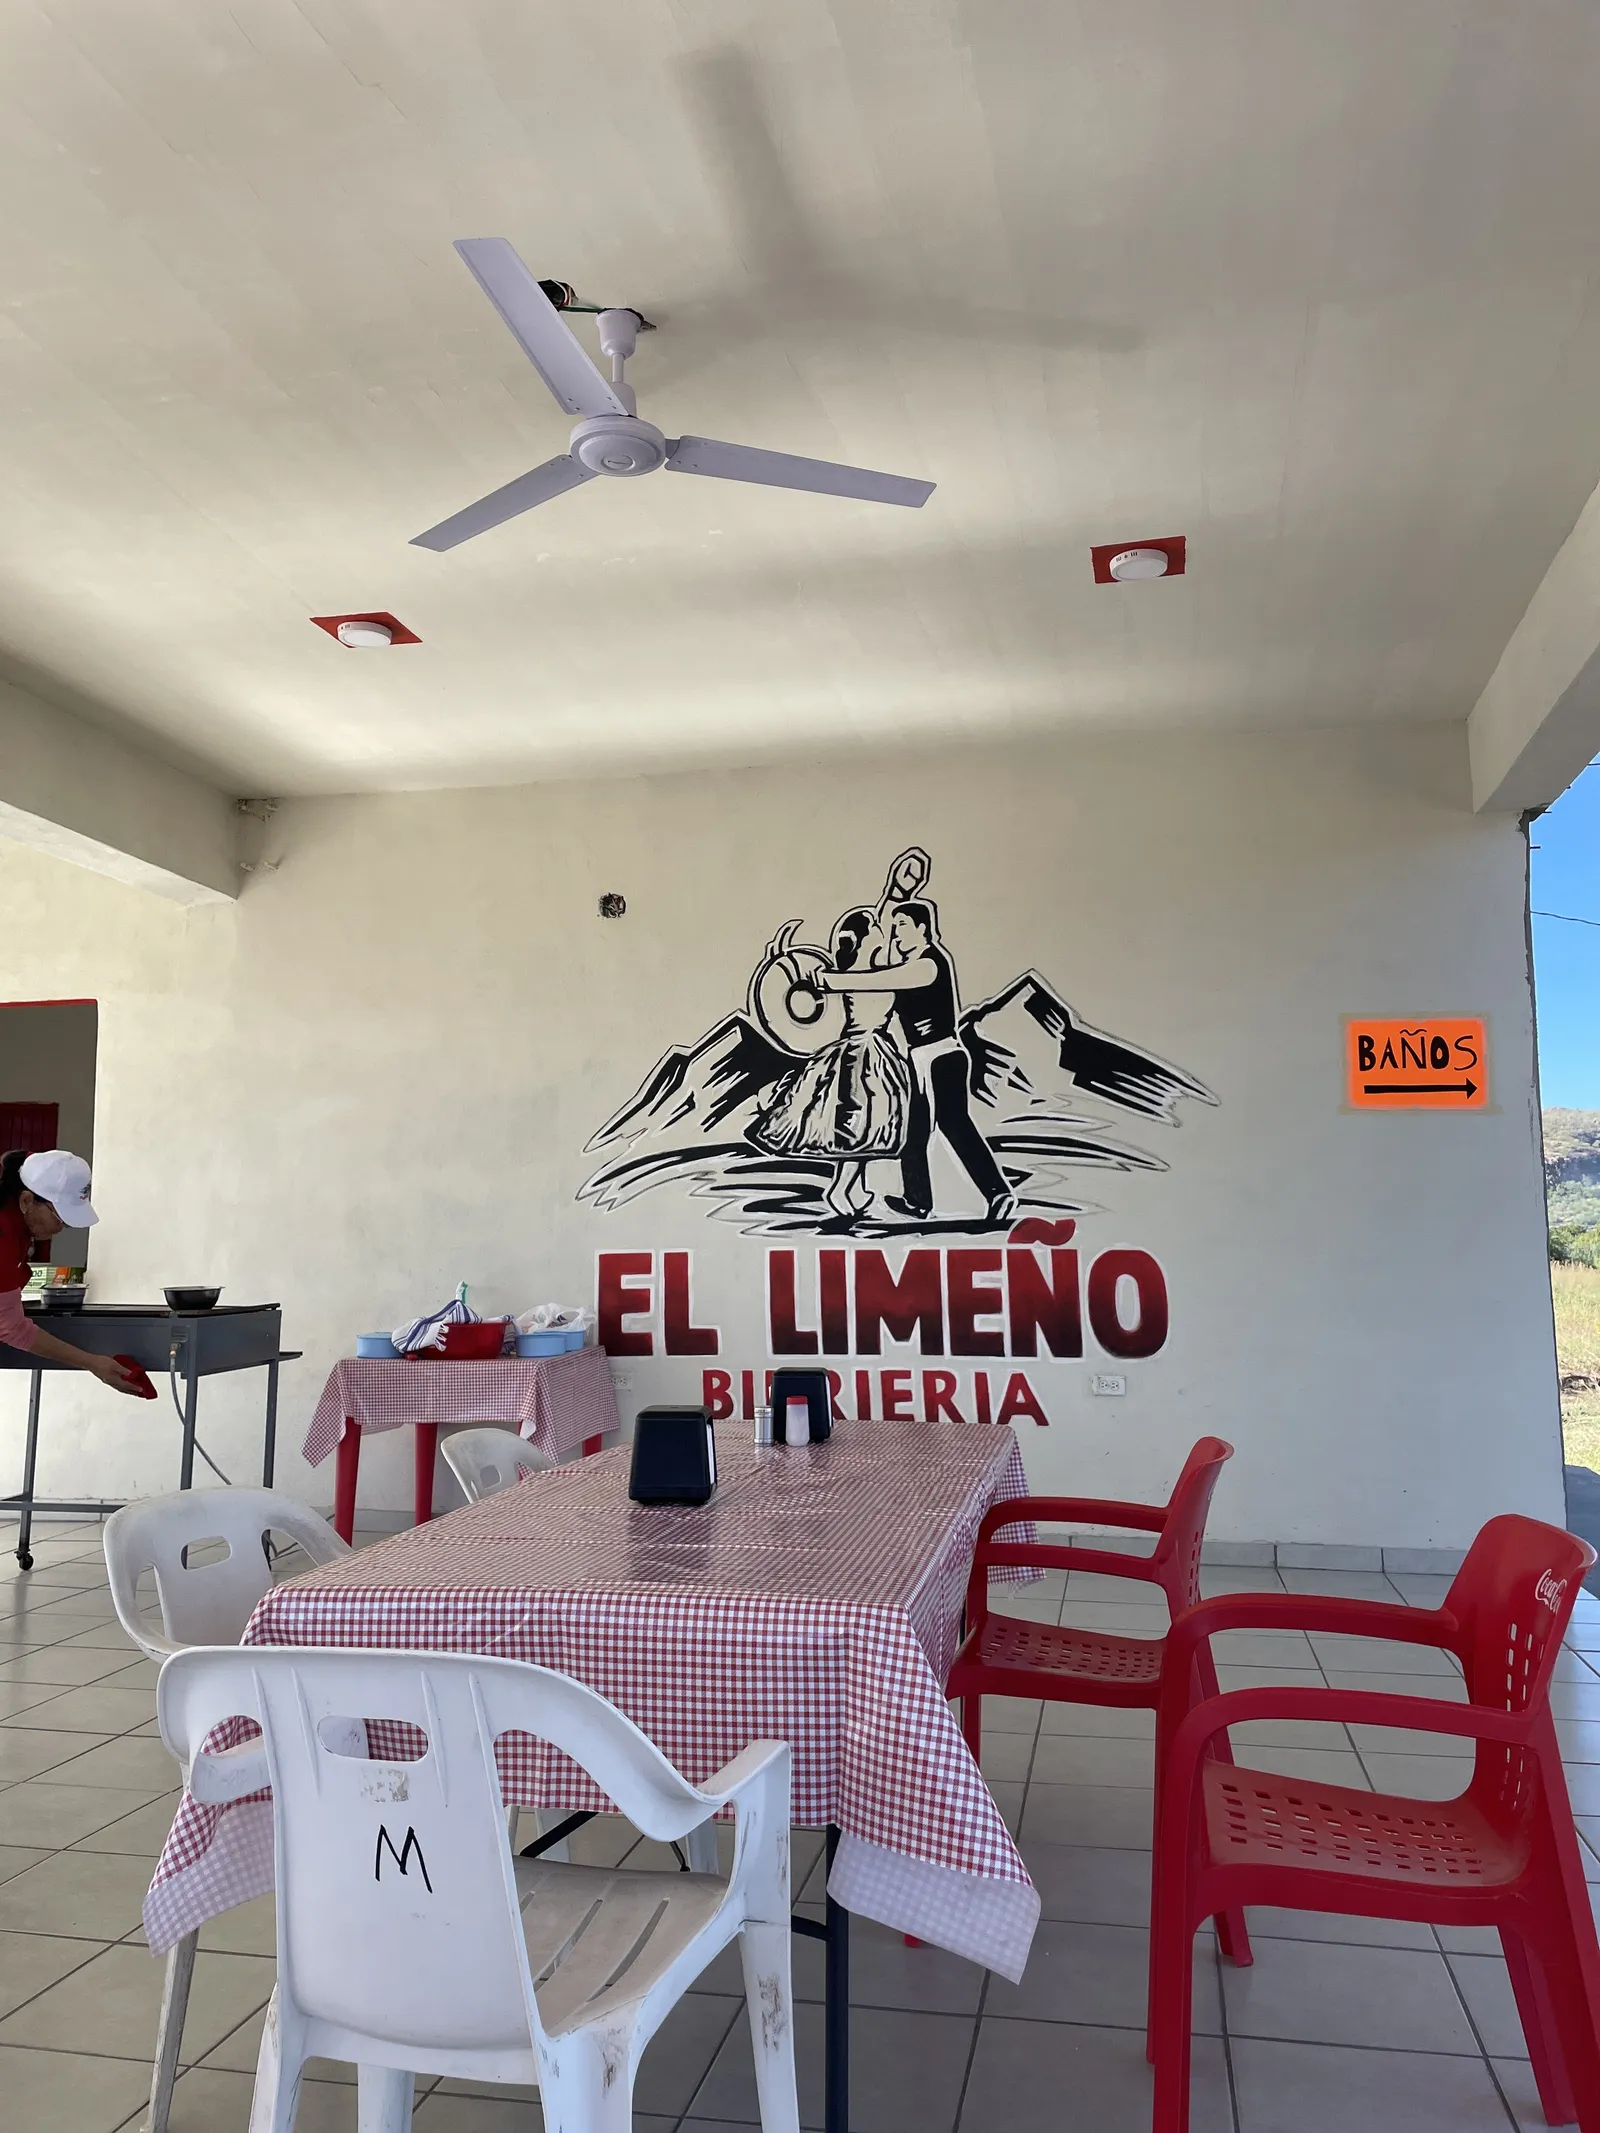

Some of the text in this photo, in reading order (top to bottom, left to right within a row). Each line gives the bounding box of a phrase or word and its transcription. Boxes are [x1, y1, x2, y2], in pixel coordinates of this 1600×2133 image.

[1358, 1028, 1477, 1071] BAÑOS
[598, 1216, 1169, 1359] EL LIMEÑO
[702, 1369, 1049, 1427] BIRIERIA
[374, 1823, 433, 1894] M
